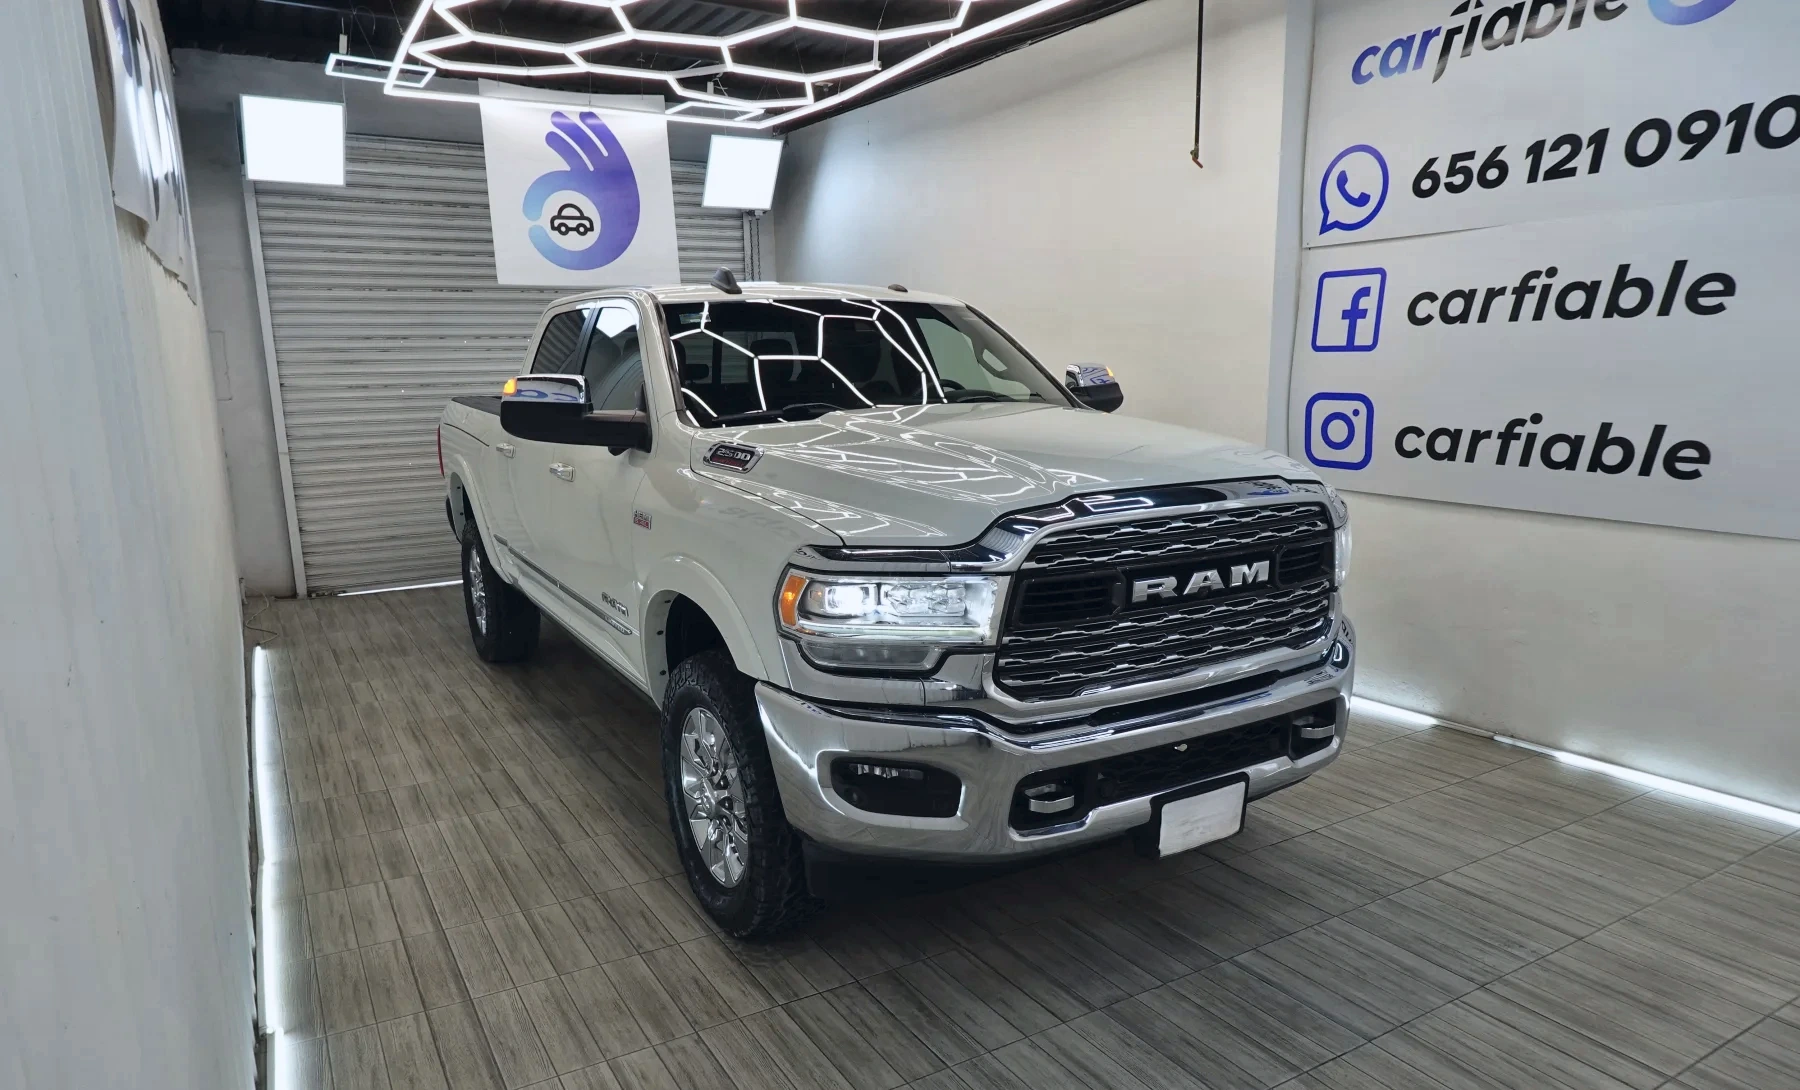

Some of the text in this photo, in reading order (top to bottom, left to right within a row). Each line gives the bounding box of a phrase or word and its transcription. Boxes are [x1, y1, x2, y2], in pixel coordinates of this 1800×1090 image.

[1411, 94, 1800, 199] 656 121 0910
[1407, 259, 1737, 327] carfiable
[716, 447, 751, 461] 2500
[1394, 412, 1712, 481] carfiable
[1132, 560, 1270, 603] RAM
